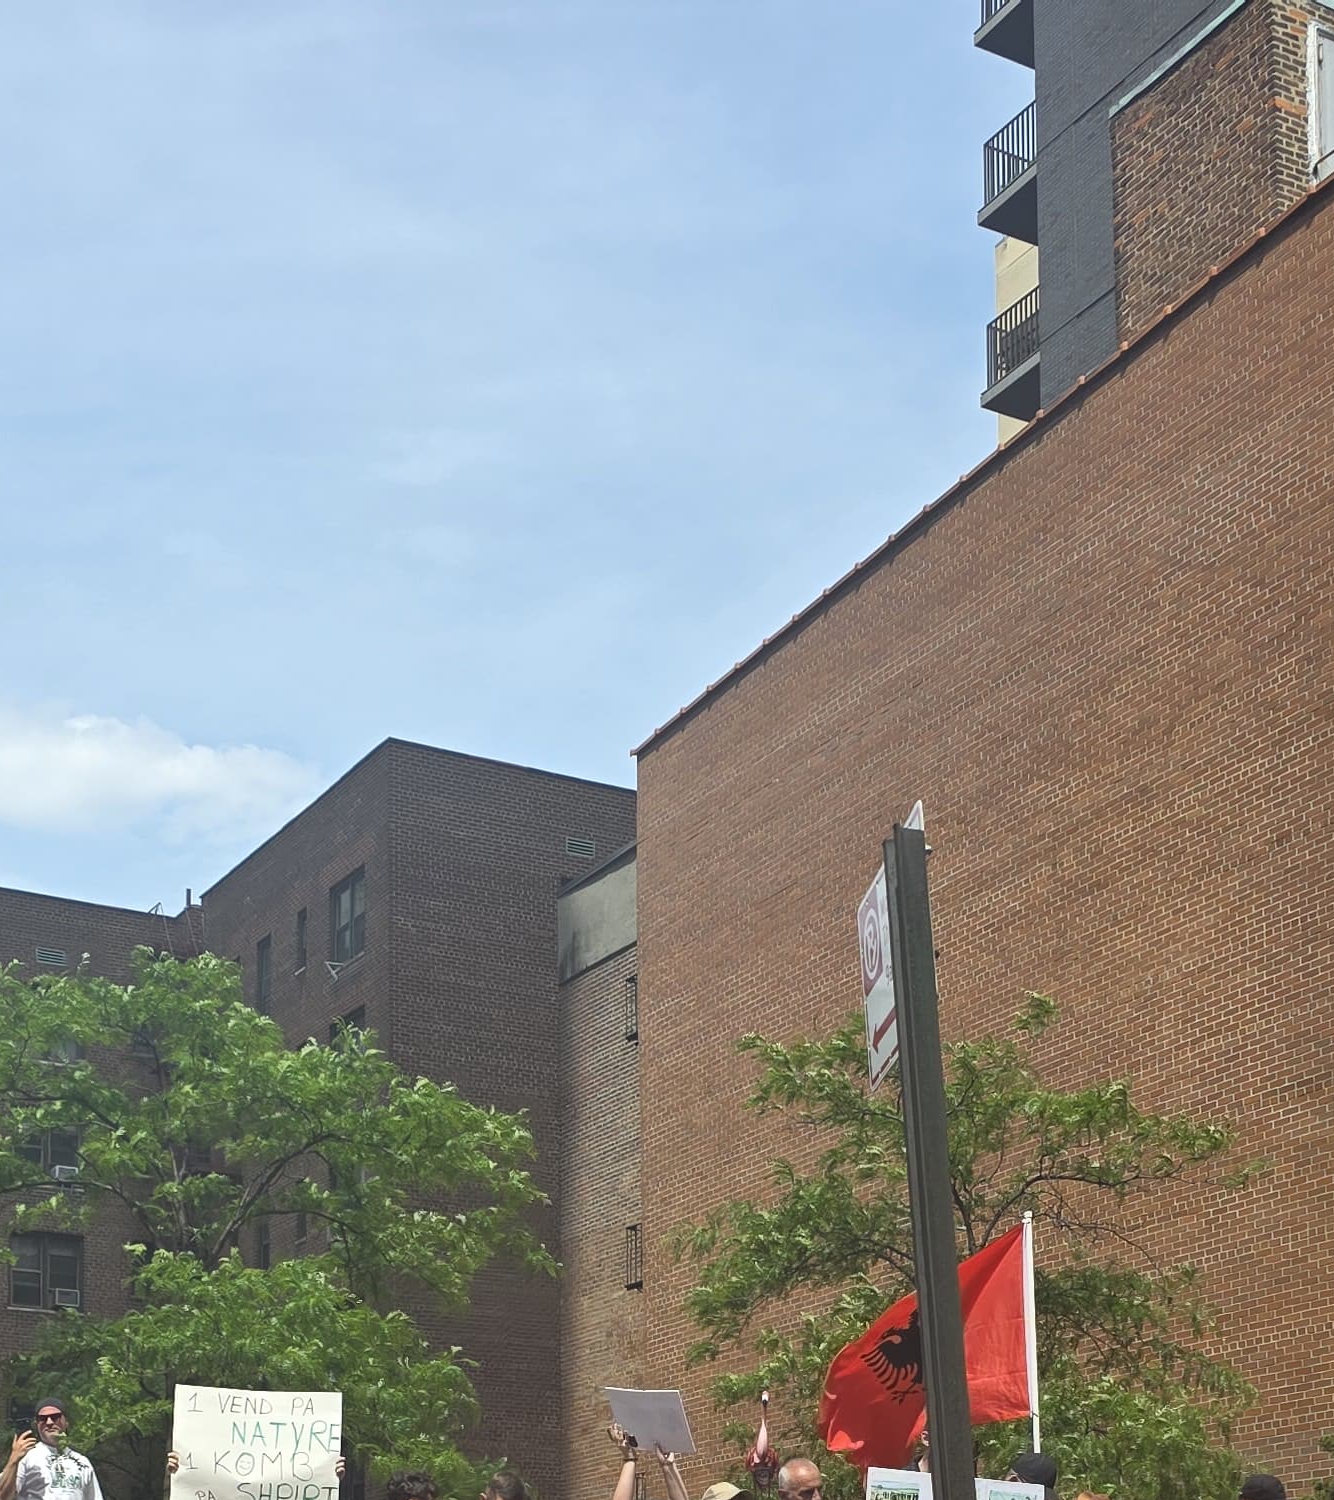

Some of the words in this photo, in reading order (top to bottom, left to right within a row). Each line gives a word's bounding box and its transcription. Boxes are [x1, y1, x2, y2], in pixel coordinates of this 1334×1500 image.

[218, 1393, 273, 1415] VEND
[291, 1397, 314, 1416] PA
[232, 1420, 340, 1456] NATYRE
[186, 1452, 198, 1469] 1
[214, 1451, 313, 1481] KOMB
